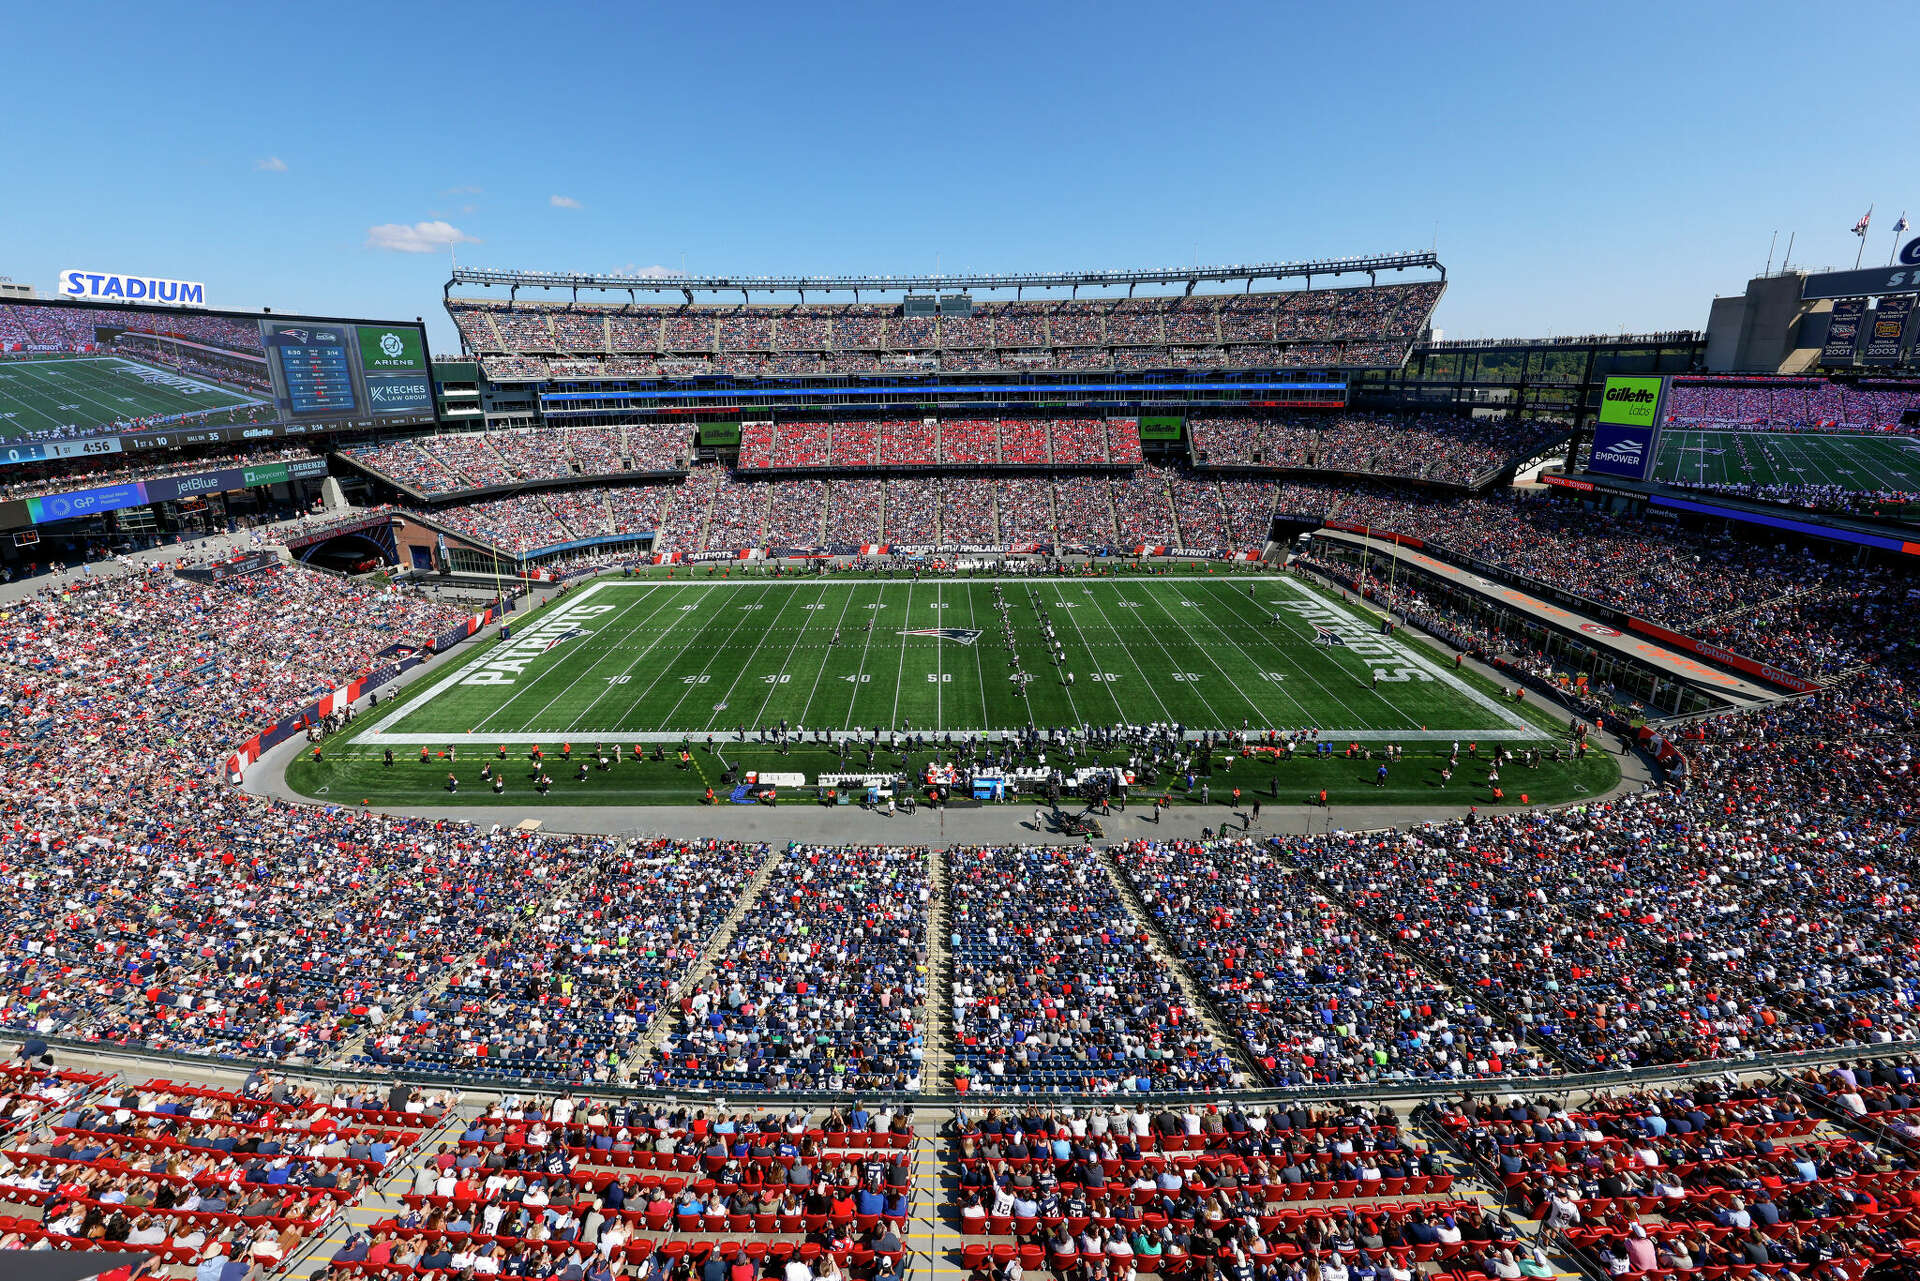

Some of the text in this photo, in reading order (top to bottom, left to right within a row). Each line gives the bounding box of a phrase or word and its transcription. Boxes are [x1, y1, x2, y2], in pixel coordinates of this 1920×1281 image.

[67, 272, 203, 304] STADIUM
[386, 385, 426, 394] KECHES
[1606, 387, 1655, 403] Gillette
[1629, 404, 1651, 417] Labs
[242, 428, 274, 438] Gillette
[1144, 423, 1176, 432] Gillette
[209, 432, 220, 441] 35
[133, 439, 139, 448] 1
[156, 437, 168, 446] 10
[53, 445, 60, 456] 1
[83, 442, 110, 453] 4:56
[8, 450, 20, 462] 0
[1595, 451, 1640, 465] EMPOWER
[255, 471, 285, 481] paycom
[176, 477, 218, 495] jetBlue
[1544, 475, 1593, 492] TOYOTA TOYOTA
[1618, 490, 1648, 500] TEMPLETON
[22, 531, 36, 544] 14
[893, 544, 1004, 553] FOREVER NEW ENGLAND
[687, 550, 734, 561] PATRIOTS
[459, 604, 616, 686] PATRIOTS
[1270, 600, 1434, 682] PATRIOTS
[1695, 642, 1734, 664] Optum
[608, 675, 632, 684] 10
[684, 675, 712, 684] 20
[765, 674, 792, 683] 30
[846, 674, 871, 683] 40
[927, 673, 953, 683] 50
[1089, 672, 1117, 682] 30
[1172, 672, 1200, 682] 20
[1258, 672, 1283, 682] 10
[1760, 666, 1806, 690] Optum
[614, 1115, 624, 1127] 75
[1714, 1144, 1723, 1156] 6
[548, 1159, 564, 1174] 85
[1412, 1167, 1420, 1177] 9
[996, 1201, 1011, 1215] 12
[1045, 1206, 1059, 1218] 12
